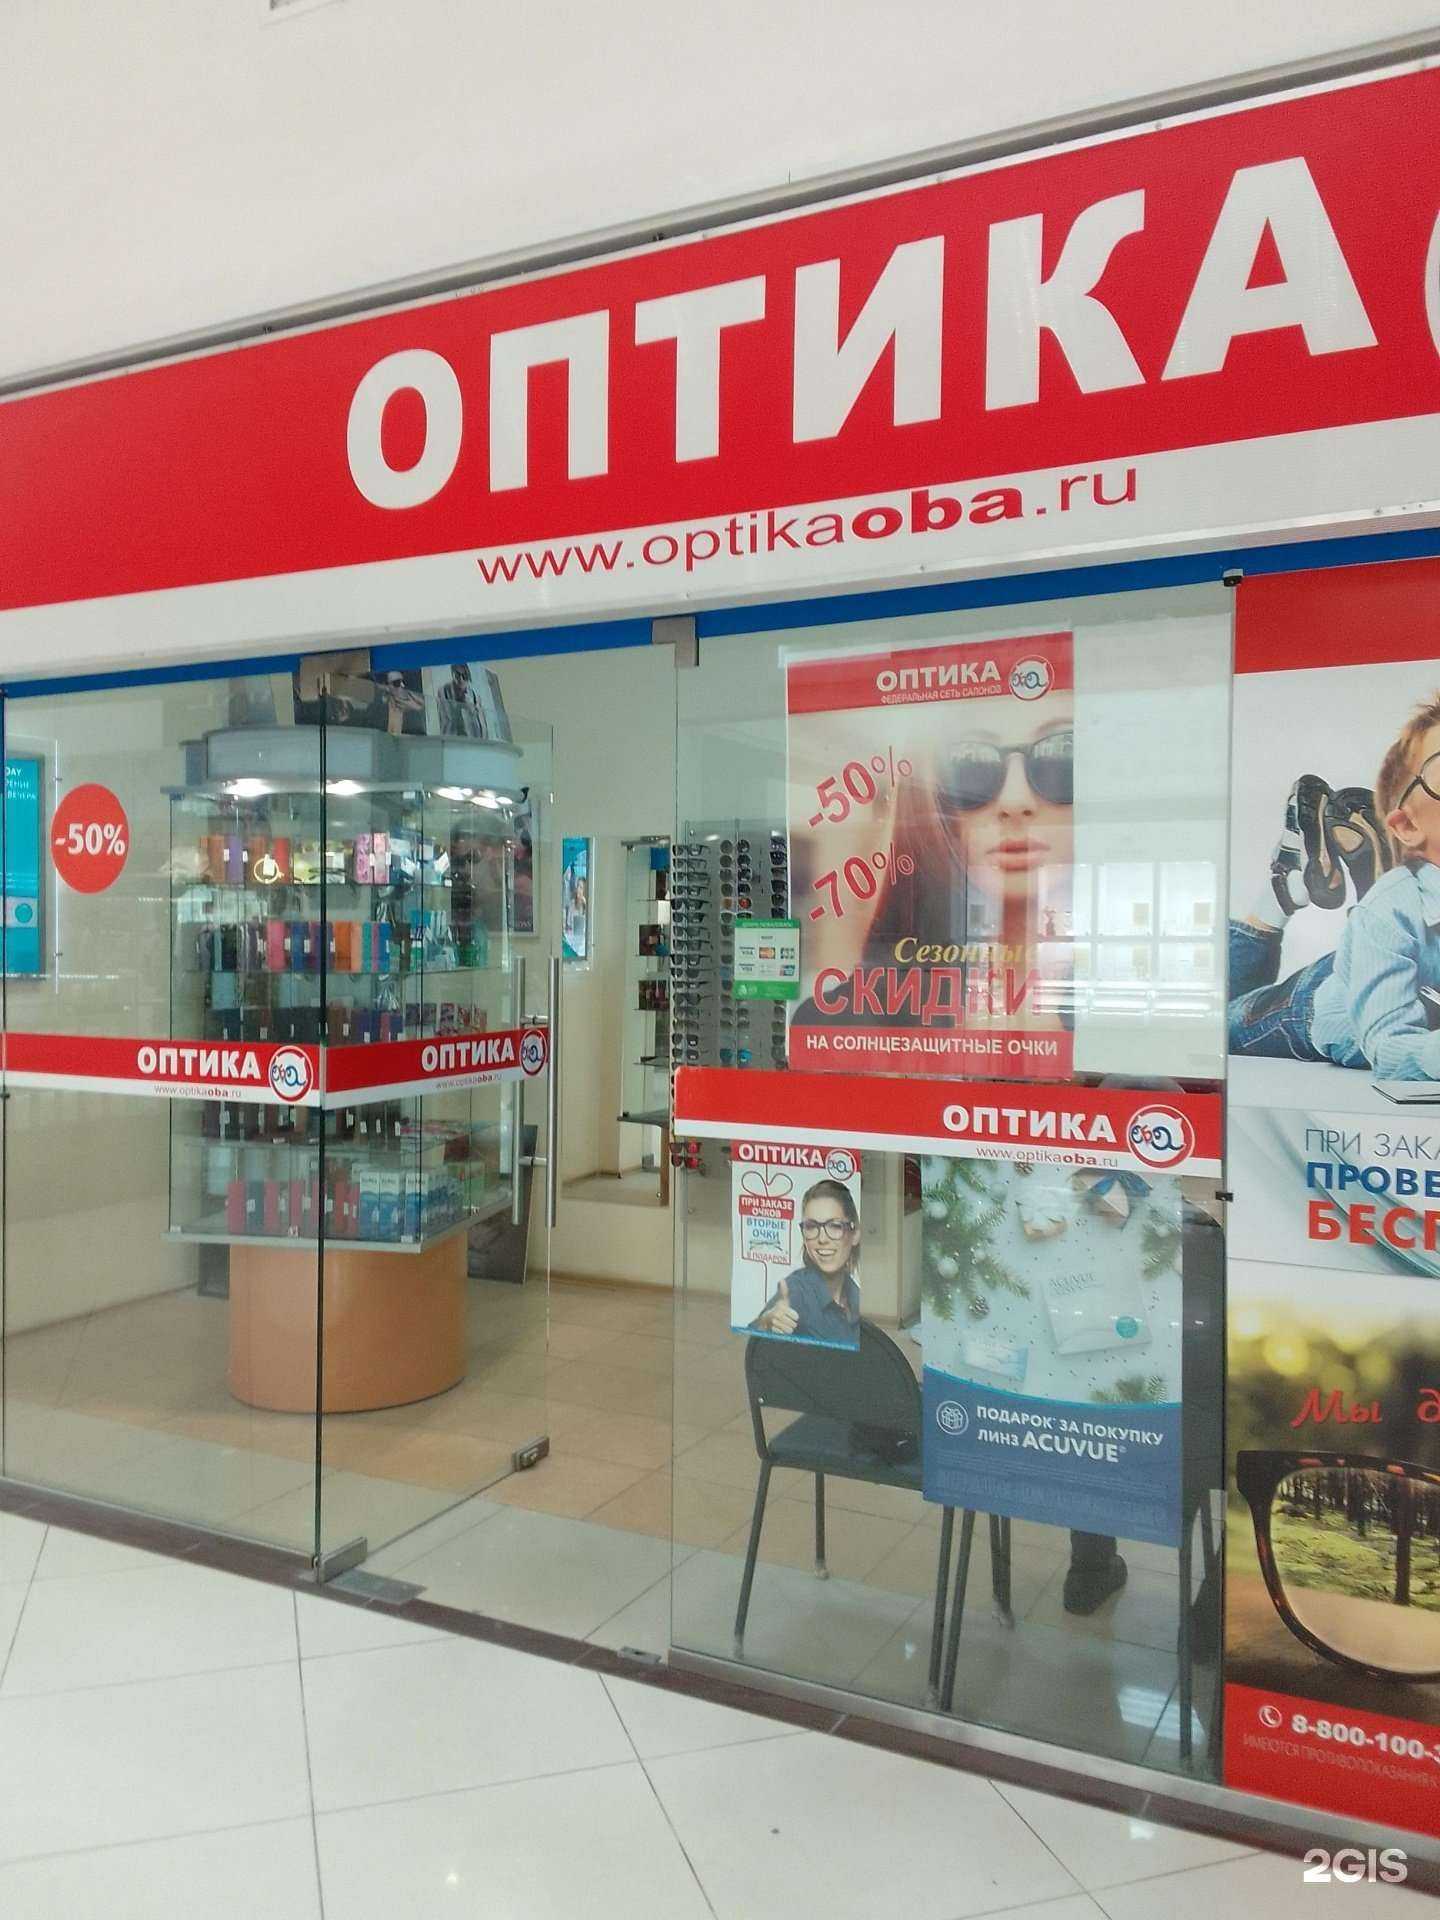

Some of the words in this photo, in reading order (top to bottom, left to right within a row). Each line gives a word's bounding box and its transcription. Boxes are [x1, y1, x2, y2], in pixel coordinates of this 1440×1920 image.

[347, 156, 1378, 509] ОПТИКА
[477, 468, 1137, 584] www.optikaoba.ru
[876, 660, 1001, 692] ОПТИКА
[881, 690, 939, 704] ФЕДЕРАЛЬНАЯ
[940, 688, 961, 698] СЕТЬ
[963, 684, 1002, 697] САЛОНОВ
[809, 745, 913, 827] -50%
[54, 822, 126, 856] -50%
[810, 841, 915, 921] -70%
[813, 966, 1042, 1026] СКИДКИ
[421, 1037, 515, 1072] ОПТИКА
[806, 1034, 829, 1050] НА
[833, 1035, 1003, 1056] СОЛНЦЕЗАЩИТНЫЕ
[1007, 1039, 1058, 1057] ОЧКИ
[137, 1046, 262, 1080] ОПТИКА
[942, 1104, 1117, 1144] ОПТИКА
[738, 1143, 825, 1167] ОПТИКА
[976, 1146, 1119, 1168] www.optikaoba.ru
[1305, 1128, 1361, 1154] ПРИ
[741, 1197, 760, 1207] ПРИ
[760, 1200, 793, 1211] ЗАКАЗЕ
[751, 1207, 781, 1218] ОЧКОВ
[752, 1229, 779, 1240] ОЧКИ
[1290, 1385, 1383, 1430] Мы
[977, 1428, 1020, 1447] ЛИНЗ
[1059, 1419, 1080, 1435] ЗА
[1083, 1422, 1164, 1446] ПОКУПКУ
